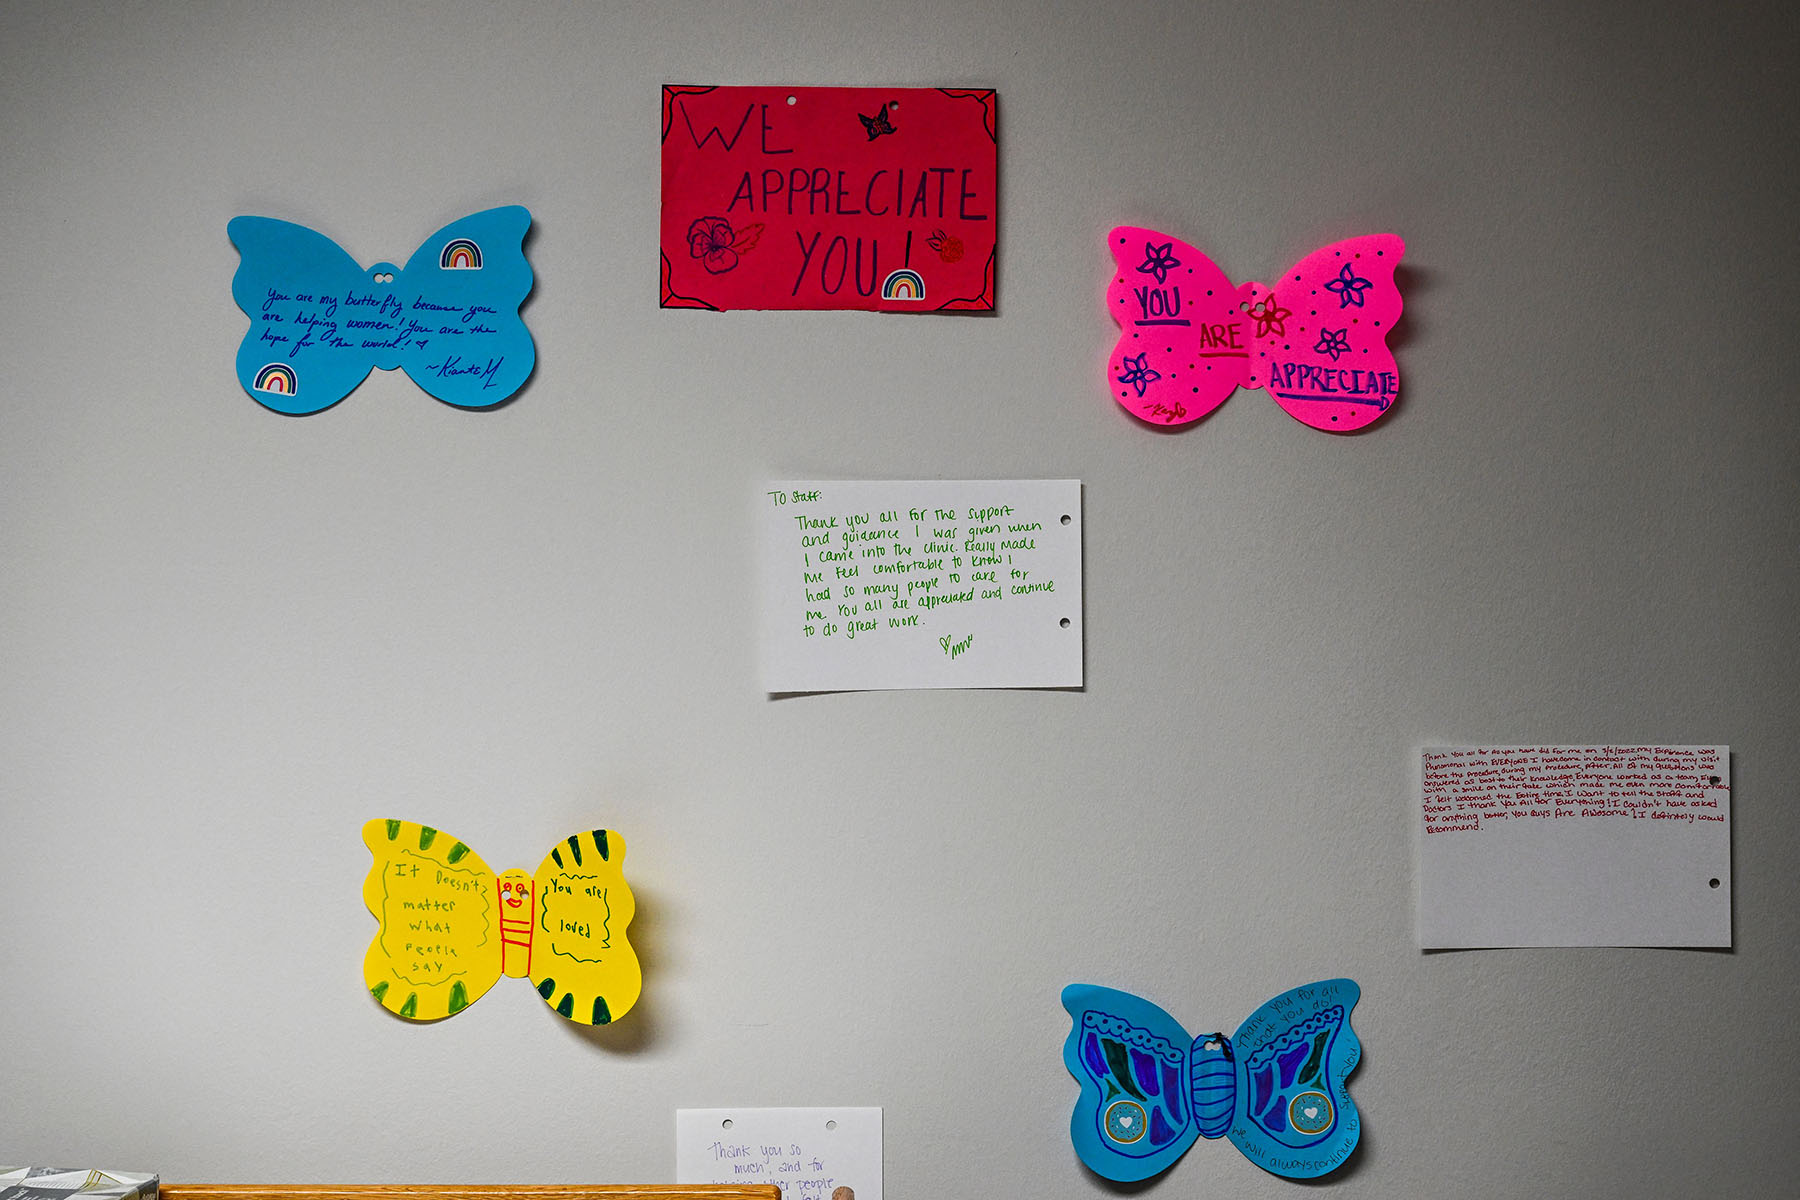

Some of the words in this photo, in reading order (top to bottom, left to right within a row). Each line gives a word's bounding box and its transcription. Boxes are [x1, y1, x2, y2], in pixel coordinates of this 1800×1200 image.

[679, 100, 793, 155] WE
[727, 168, 987, 220] APPRECIATE
[262, 288, 291, 311] You
[296, 294, 313, 302] are
[320, 296, 337, 317] my
[345, 290, 402, 319] butterfly
[413, 296, 463, 312] because
[462, 305, 496, 323] you
[1134, 286, 1180, 320] YOU
[262, 313, 283, 321] are
[294, 312, 337, 341] helping
[399, 320, 433, 340] You
[439, 326, 464, 334] are
[470, 325, 496, 334] the
[1200, 323, 1244, 350] ARE
[260, 328, 288, 347] hope
[289, 333, 314, 358] for
[329, 336, 353, 347] the
[794, 516, 838, 530] Thank
[846, 513, 869, 532] you
[880, 511, 898, 522] all
[968, 505, 1014, 523] support
[802, 532, 830, 547] and
[842, 530, 899, 550] guidance
[916, 525, 919, 537] I
[933, 528, 957, 538] was
[969, 524, 1000, 542] given
[1008, 523, 1042, 532] when
[805, 553, 809, 567] I
[819, 551, 854, 562] came
[859, 544, 885, 558] into
[894, 543, 912, 556] the
[873, 559, 944, 575] comfortable
[952, 556, 962, 568] to
[1009, 555, 1012, 564] I
[806, 588, 830, 602] had
[844, 586, 854, 598] so
[864, 584, 898, 600] many
[907, 577, 938, 596] people
[949, 573, 960, 583] to
[972, 571, 997, 582] care
[1011, 569, 1028, 580] for
[838, 604, 857, 616] You
[865, 600, 882, 611] all
[893, 600, 909, 609] are
[981, 587, 1002, 600] and
[1011, 581, 1055, 595] continue
[804, 625, 814, 637] to
[823, 623, 838, 636] do
[847, 619, 878, 639] great
[1555, 808, 1576, 818] Are
[395, 863, 420, 877] It
[551, 878, 572, 895] You
[585, 886, 603, 898] are
[403, 900, 455, 912] matter
[560, 920, 591, 938] loved
[1270, 997, 1293, 1013] you
[1298, 989, 1315, 1001] for
[1322, 986, 1339, 995] all
[1280, 1008, 1304, 1022] you
[707, 1142, 752, 1161] Thank
[760, 1145, 782, 1164] you
[790, 1144, 801, 1156] so
[779, 1161, 801, 1173] and
[808, 1157, 824, 1172] for
[1269, 1158, 1312, 1170] always
[796, 1179, 834, 1195] people
